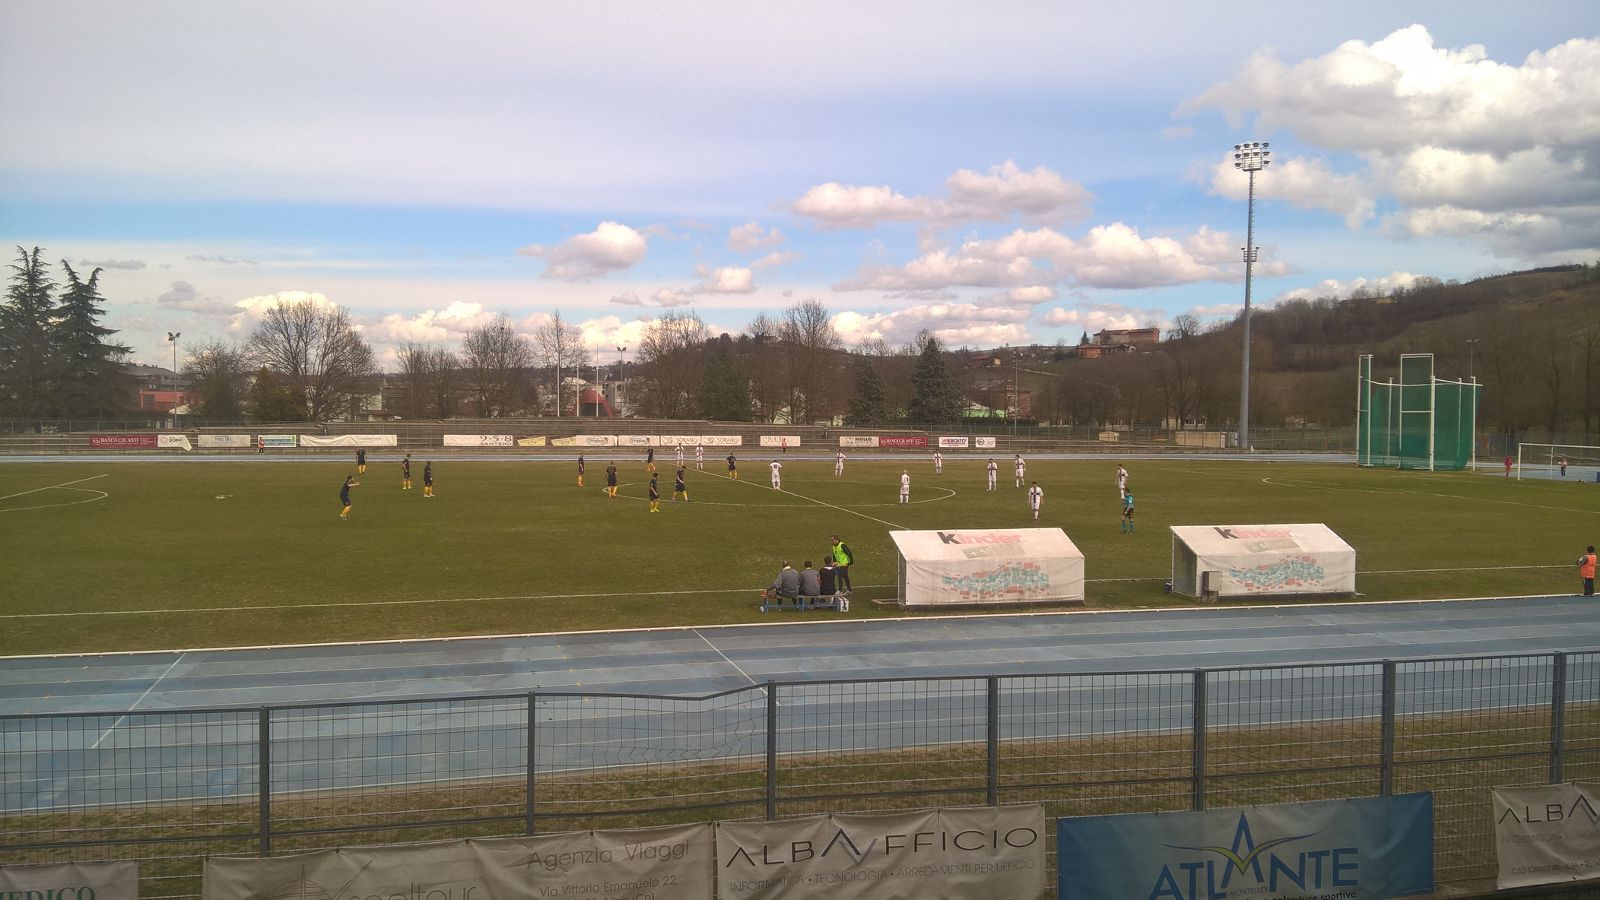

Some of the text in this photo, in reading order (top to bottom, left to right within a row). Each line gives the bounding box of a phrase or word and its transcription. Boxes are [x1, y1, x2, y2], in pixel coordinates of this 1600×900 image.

[937, 531, 1022, 545] kinder
[527, 839, 689, 871] Agenzia Viaggi
[1147, 810, 1359, 900] ATLANTE
[540, 875, 677, 897] Via Vittorio Emanuele 22
[730, 858, 1036, 893] INFORMATICA TECNOLOGIA ARREDAMENTI PER UFFICIO
